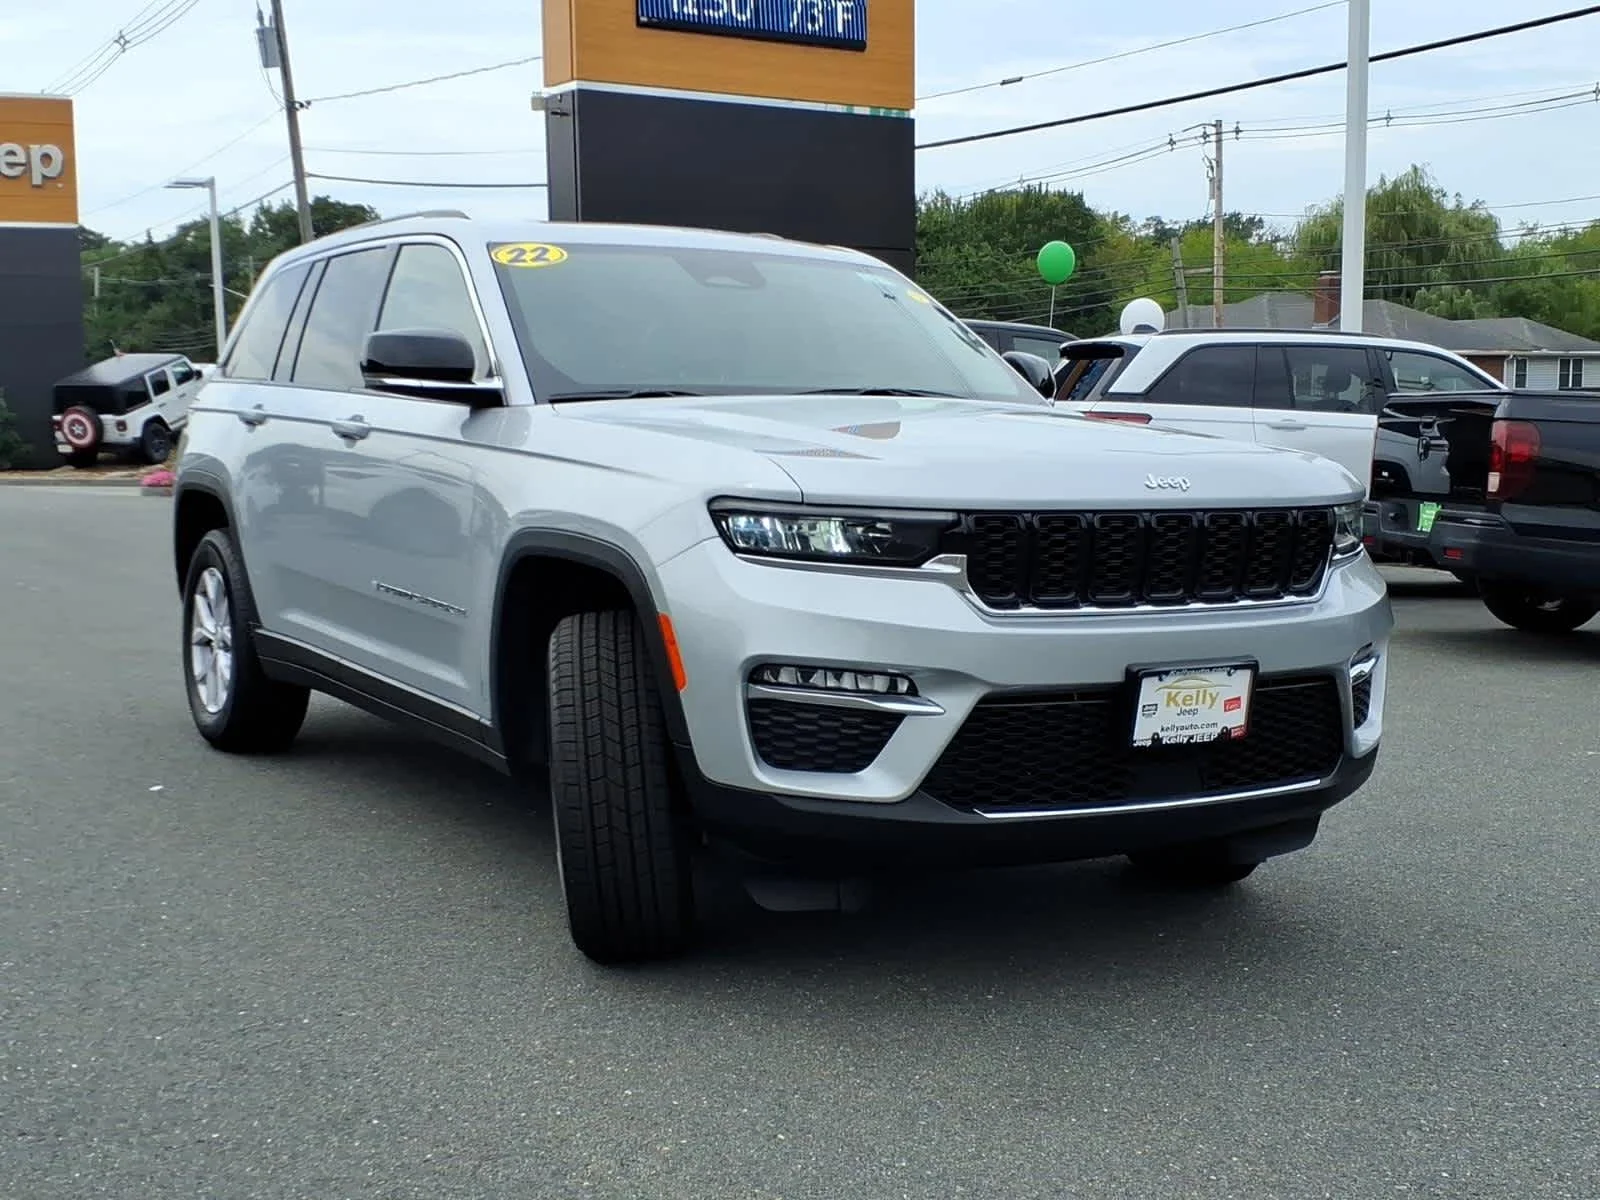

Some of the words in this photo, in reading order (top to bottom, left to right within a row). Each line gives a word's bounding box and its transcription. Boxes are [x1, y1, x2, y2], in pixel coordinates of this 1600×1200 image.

[506, 246, 552, 263] 22
[1143, 473, 1191, 492] Jeep
[1166, 689, 1220, 709] Kelly
[1176, 707, 1199, 717] Jeep
[1160, 722, 1218, 732] kellyauto.com
[1162, 734, 1189, 745] Kelly
